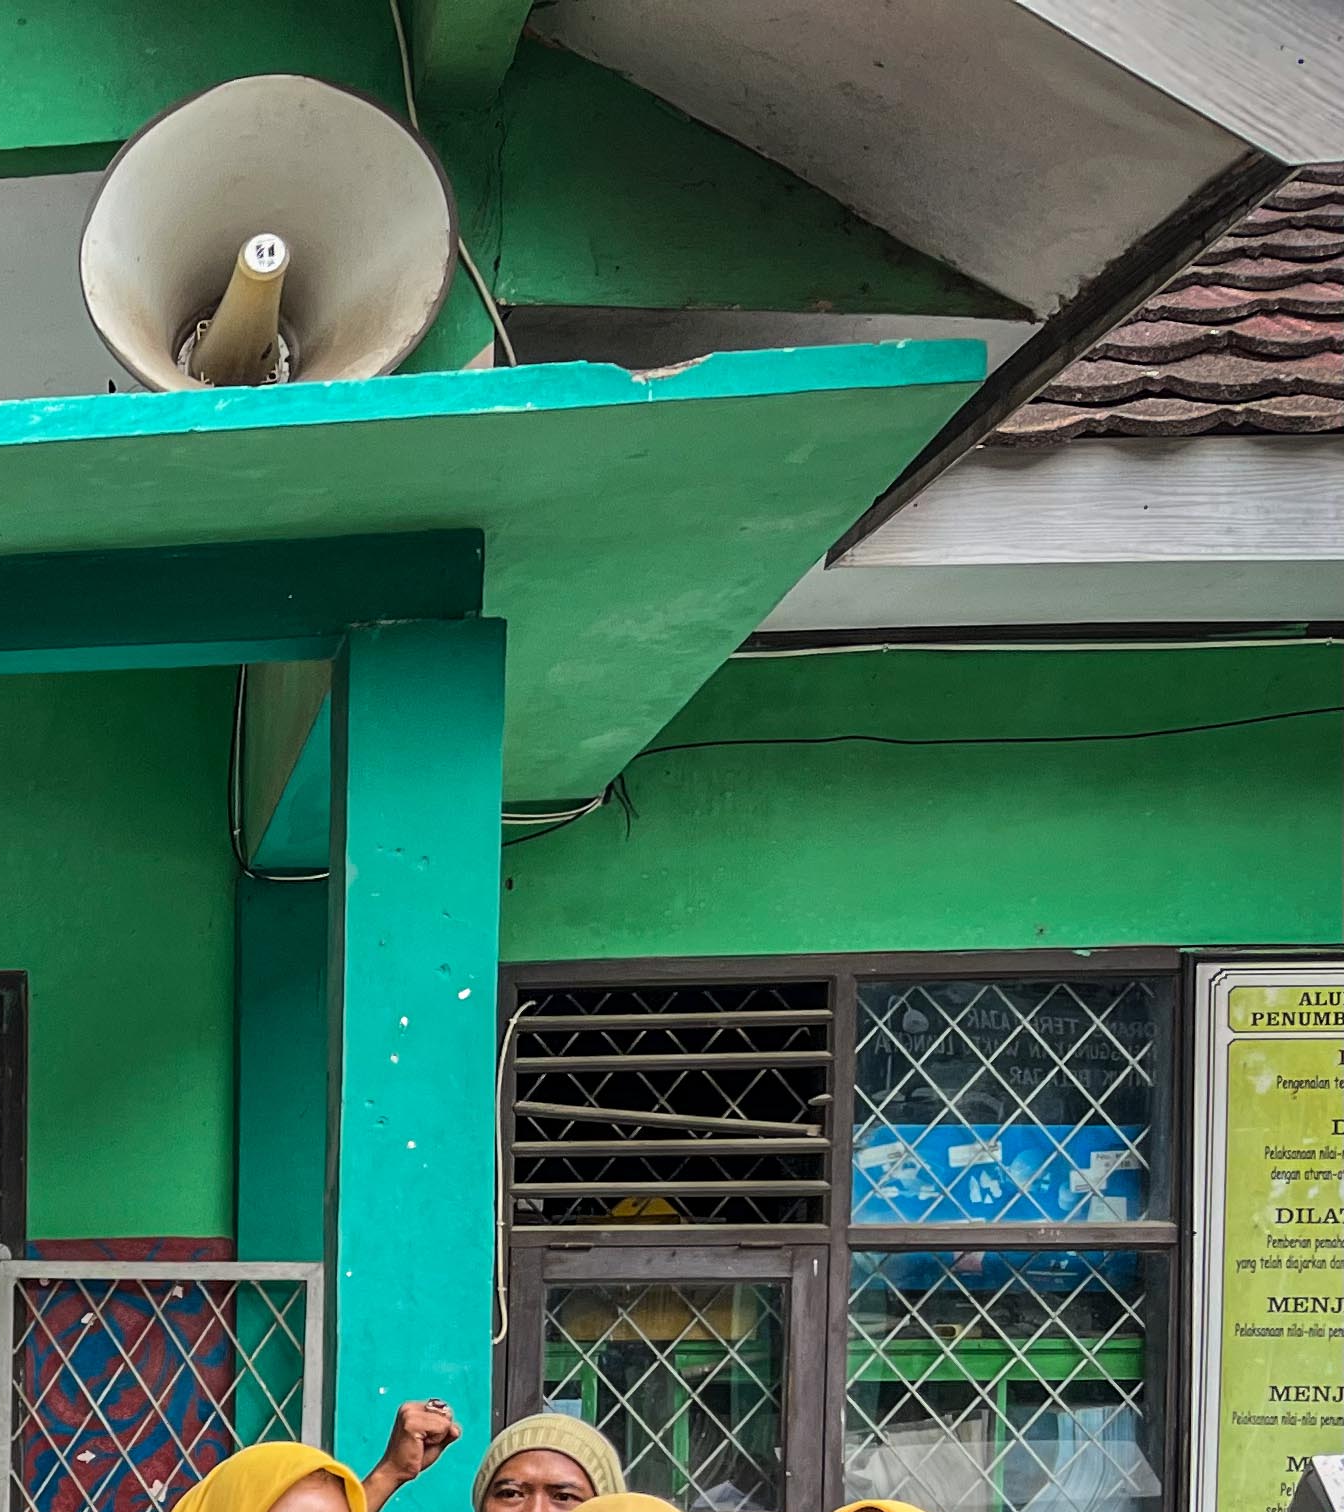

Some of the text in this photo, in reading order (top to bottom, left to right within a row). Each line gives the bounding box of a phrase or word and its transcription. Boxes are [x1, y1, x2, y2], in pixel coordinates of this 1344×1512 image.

[1299, 992, 1344, 1006] ALU
[1276, 1074, 1330, 1094] Pengenalan
[1271, 1166, 1301, 1184] dengan
